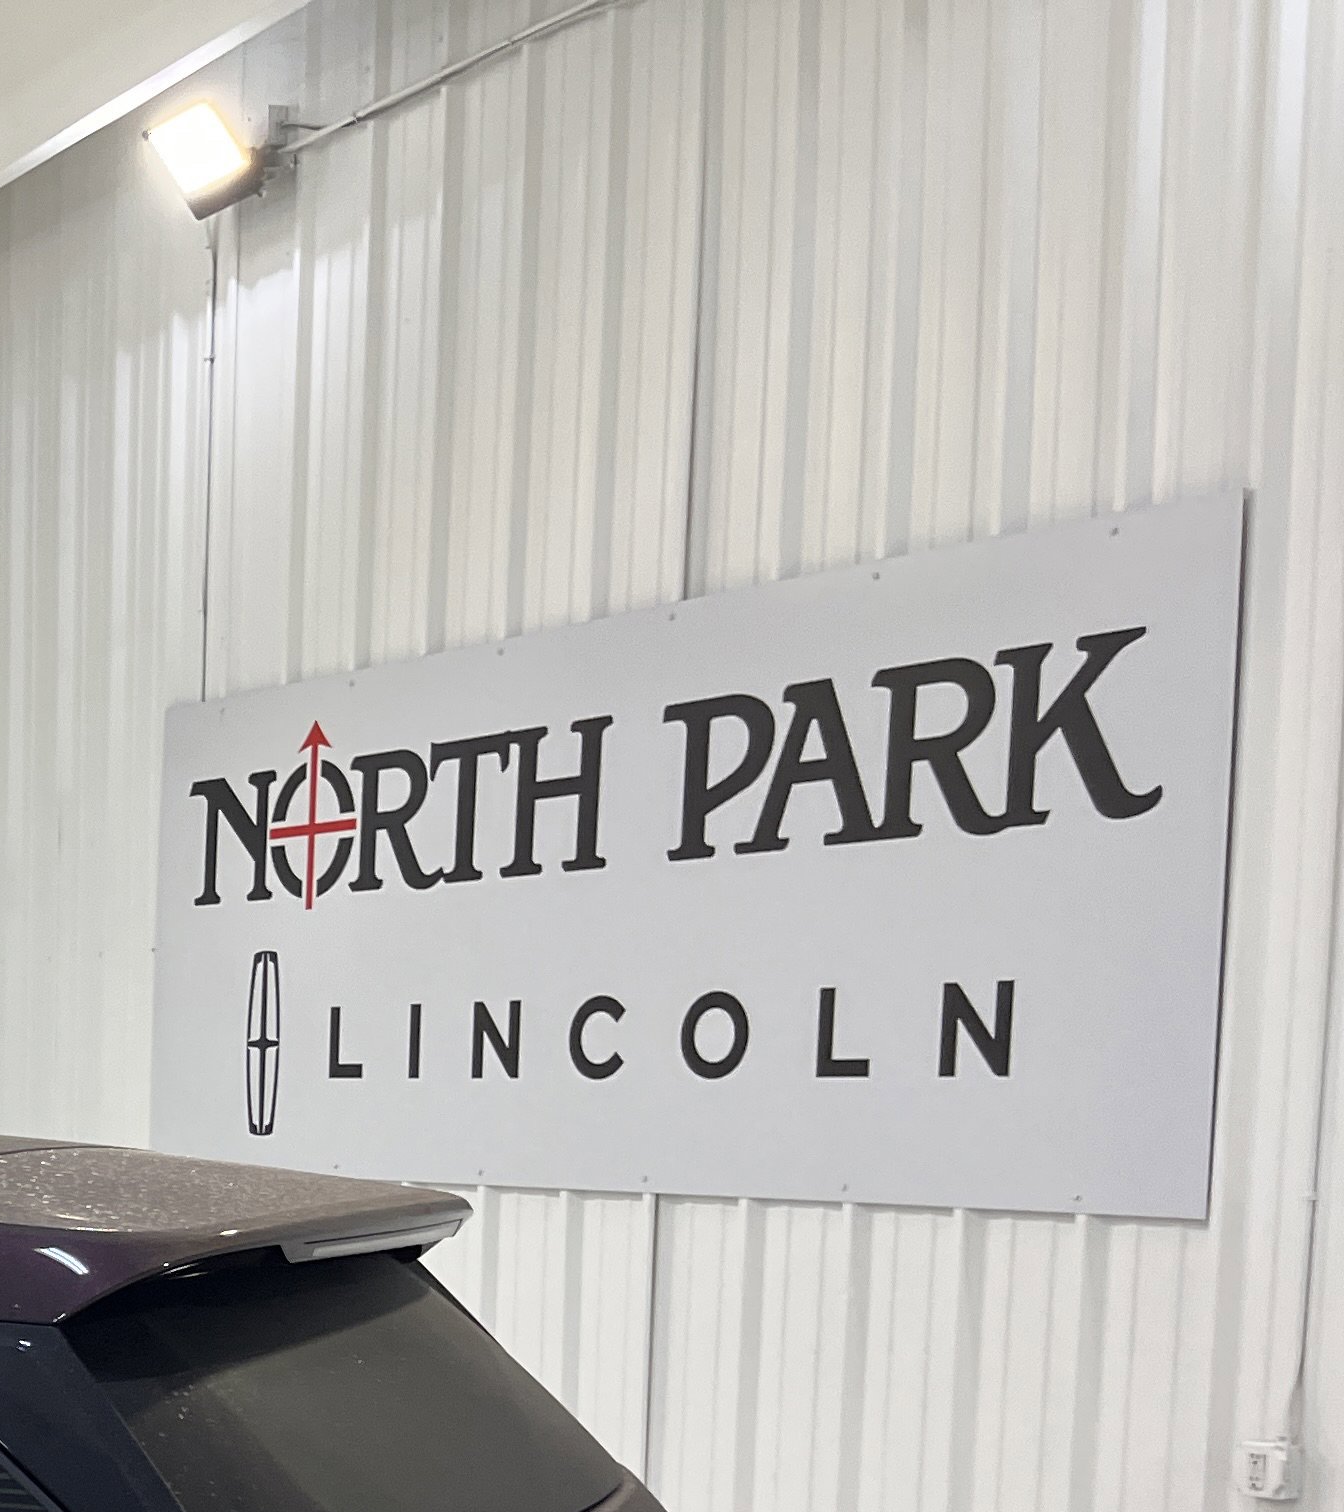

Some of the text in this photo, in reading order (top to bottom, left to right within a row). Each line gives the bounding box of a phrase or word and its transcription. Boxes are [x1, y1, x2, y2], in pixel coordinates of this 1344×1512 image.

[190, 625, 1163, 908] NORTH PARK
[328, 979, 1016, 1079] LINCOLN
